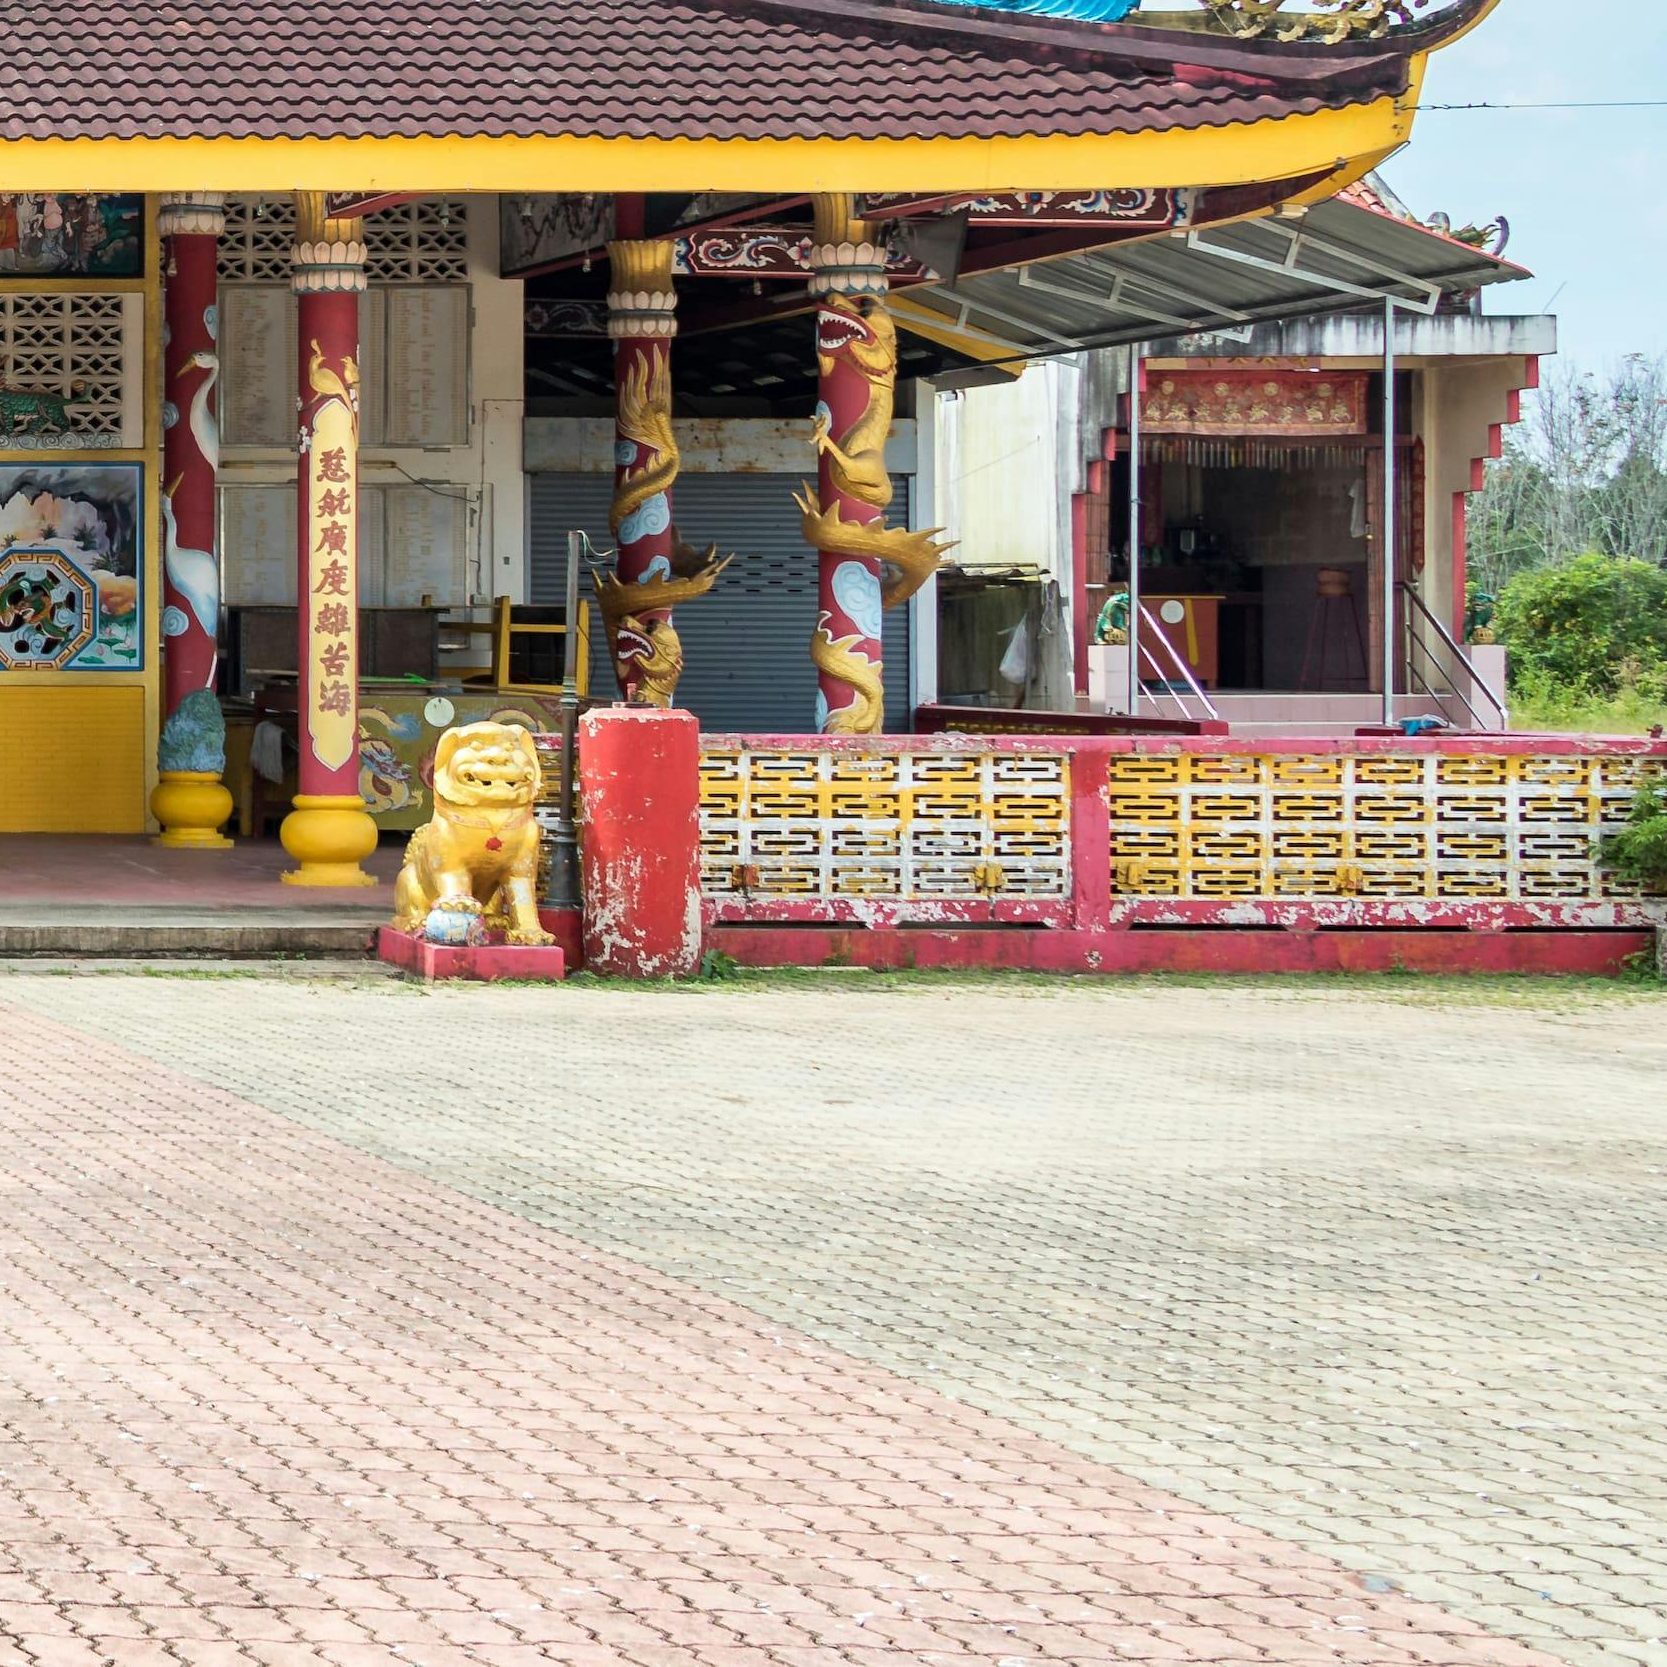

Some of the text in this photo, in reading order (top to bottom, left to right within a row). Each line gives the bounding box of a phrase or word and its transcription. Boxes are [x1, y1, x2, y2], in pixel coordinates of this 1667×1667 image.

[311, 445, 352, 718] 慈航廣度離苦海
